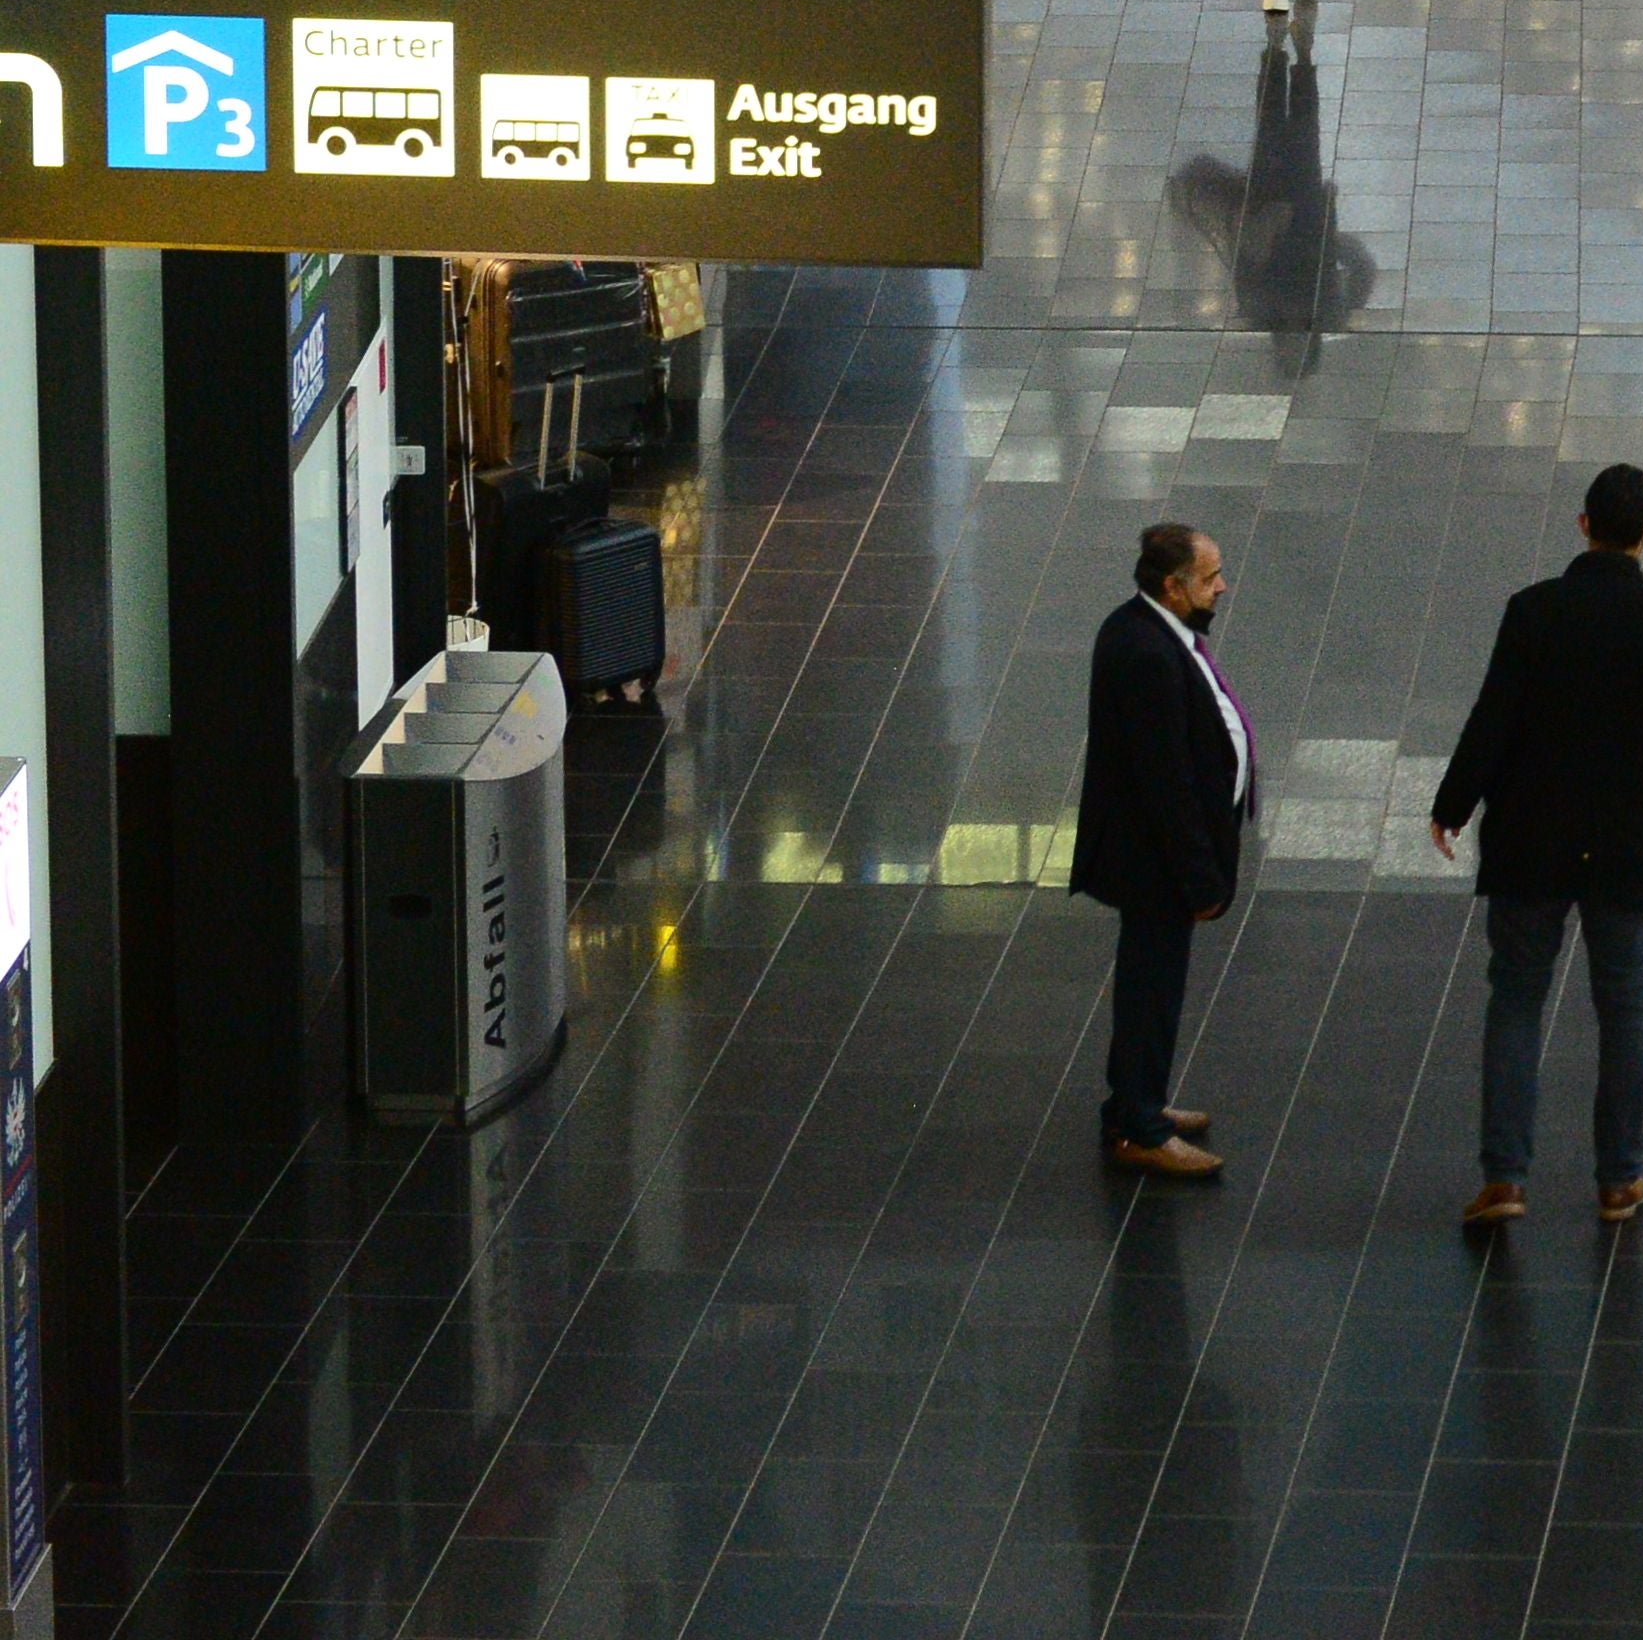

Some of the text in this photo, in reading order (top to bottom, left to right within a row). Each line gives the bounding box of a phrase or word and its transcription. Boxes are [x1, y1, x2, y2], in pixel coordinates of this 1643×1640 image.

[304, 29, 443, 58] Charter
[727, 83, 937, 136] Ausgang
[729, 135, 822, 178] Exit
[482, 875, 506, 1049] Abfall
